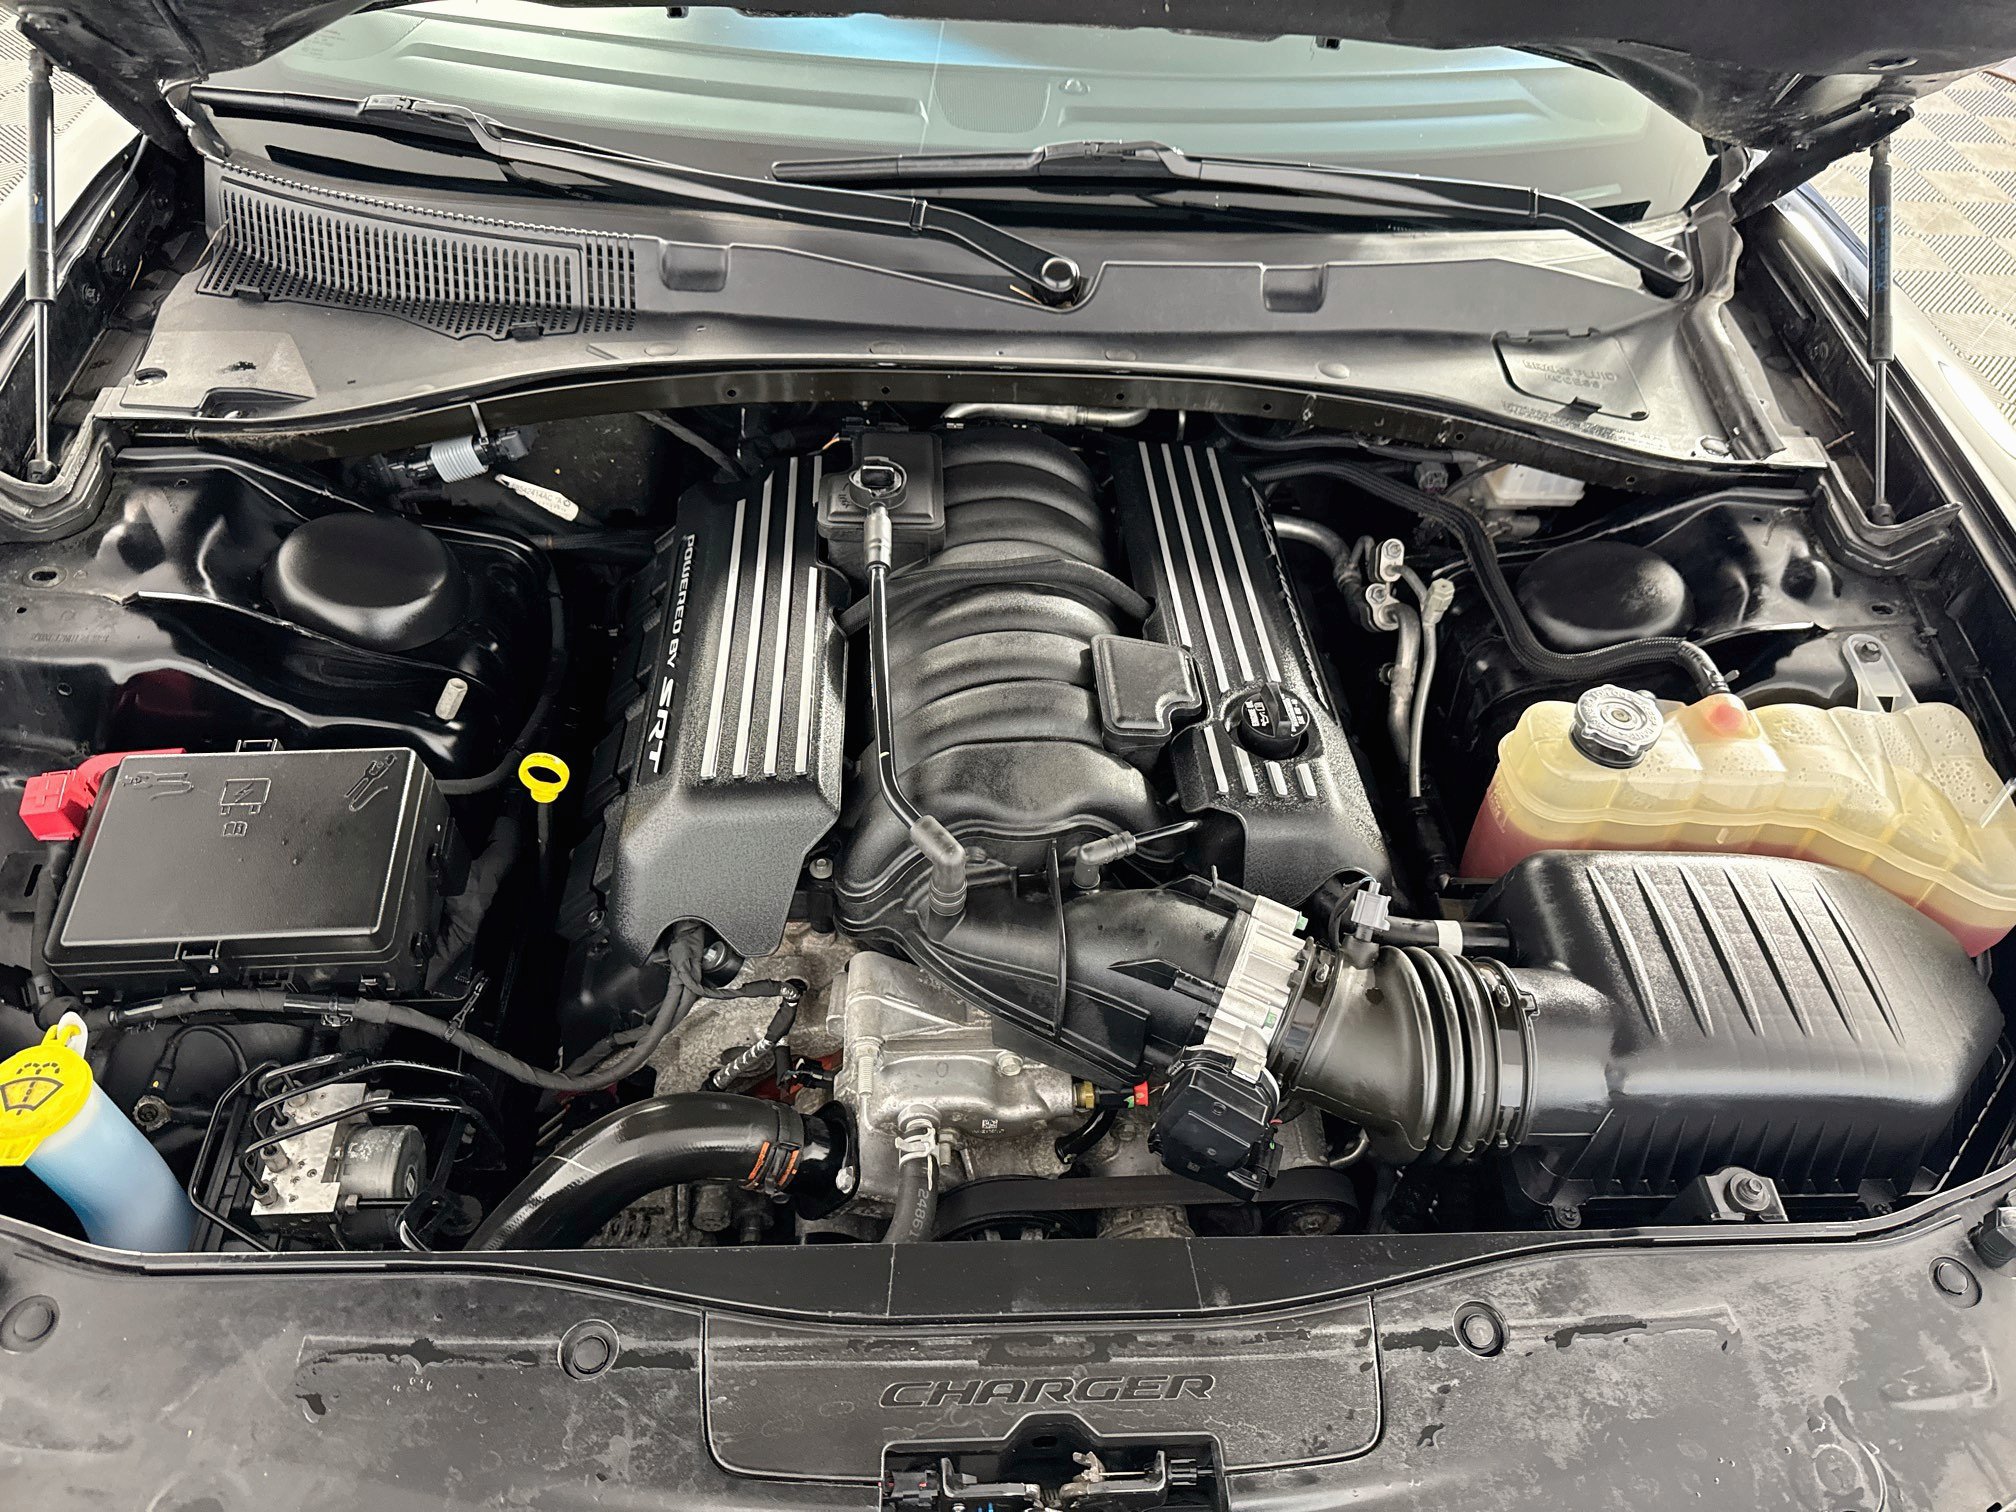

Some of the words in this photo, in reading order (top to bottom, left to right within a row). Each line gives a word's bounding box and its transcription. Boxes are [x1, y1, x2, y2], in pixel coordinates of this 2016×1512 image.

[671, 533, 696, 635] POWERED
[667, 638, 681, 669] BY
[647, 676, 675, 774] SRT
[910, 1188, 930, 1237] 24861
[879, 1374, 1216, 1408] CHARGER
